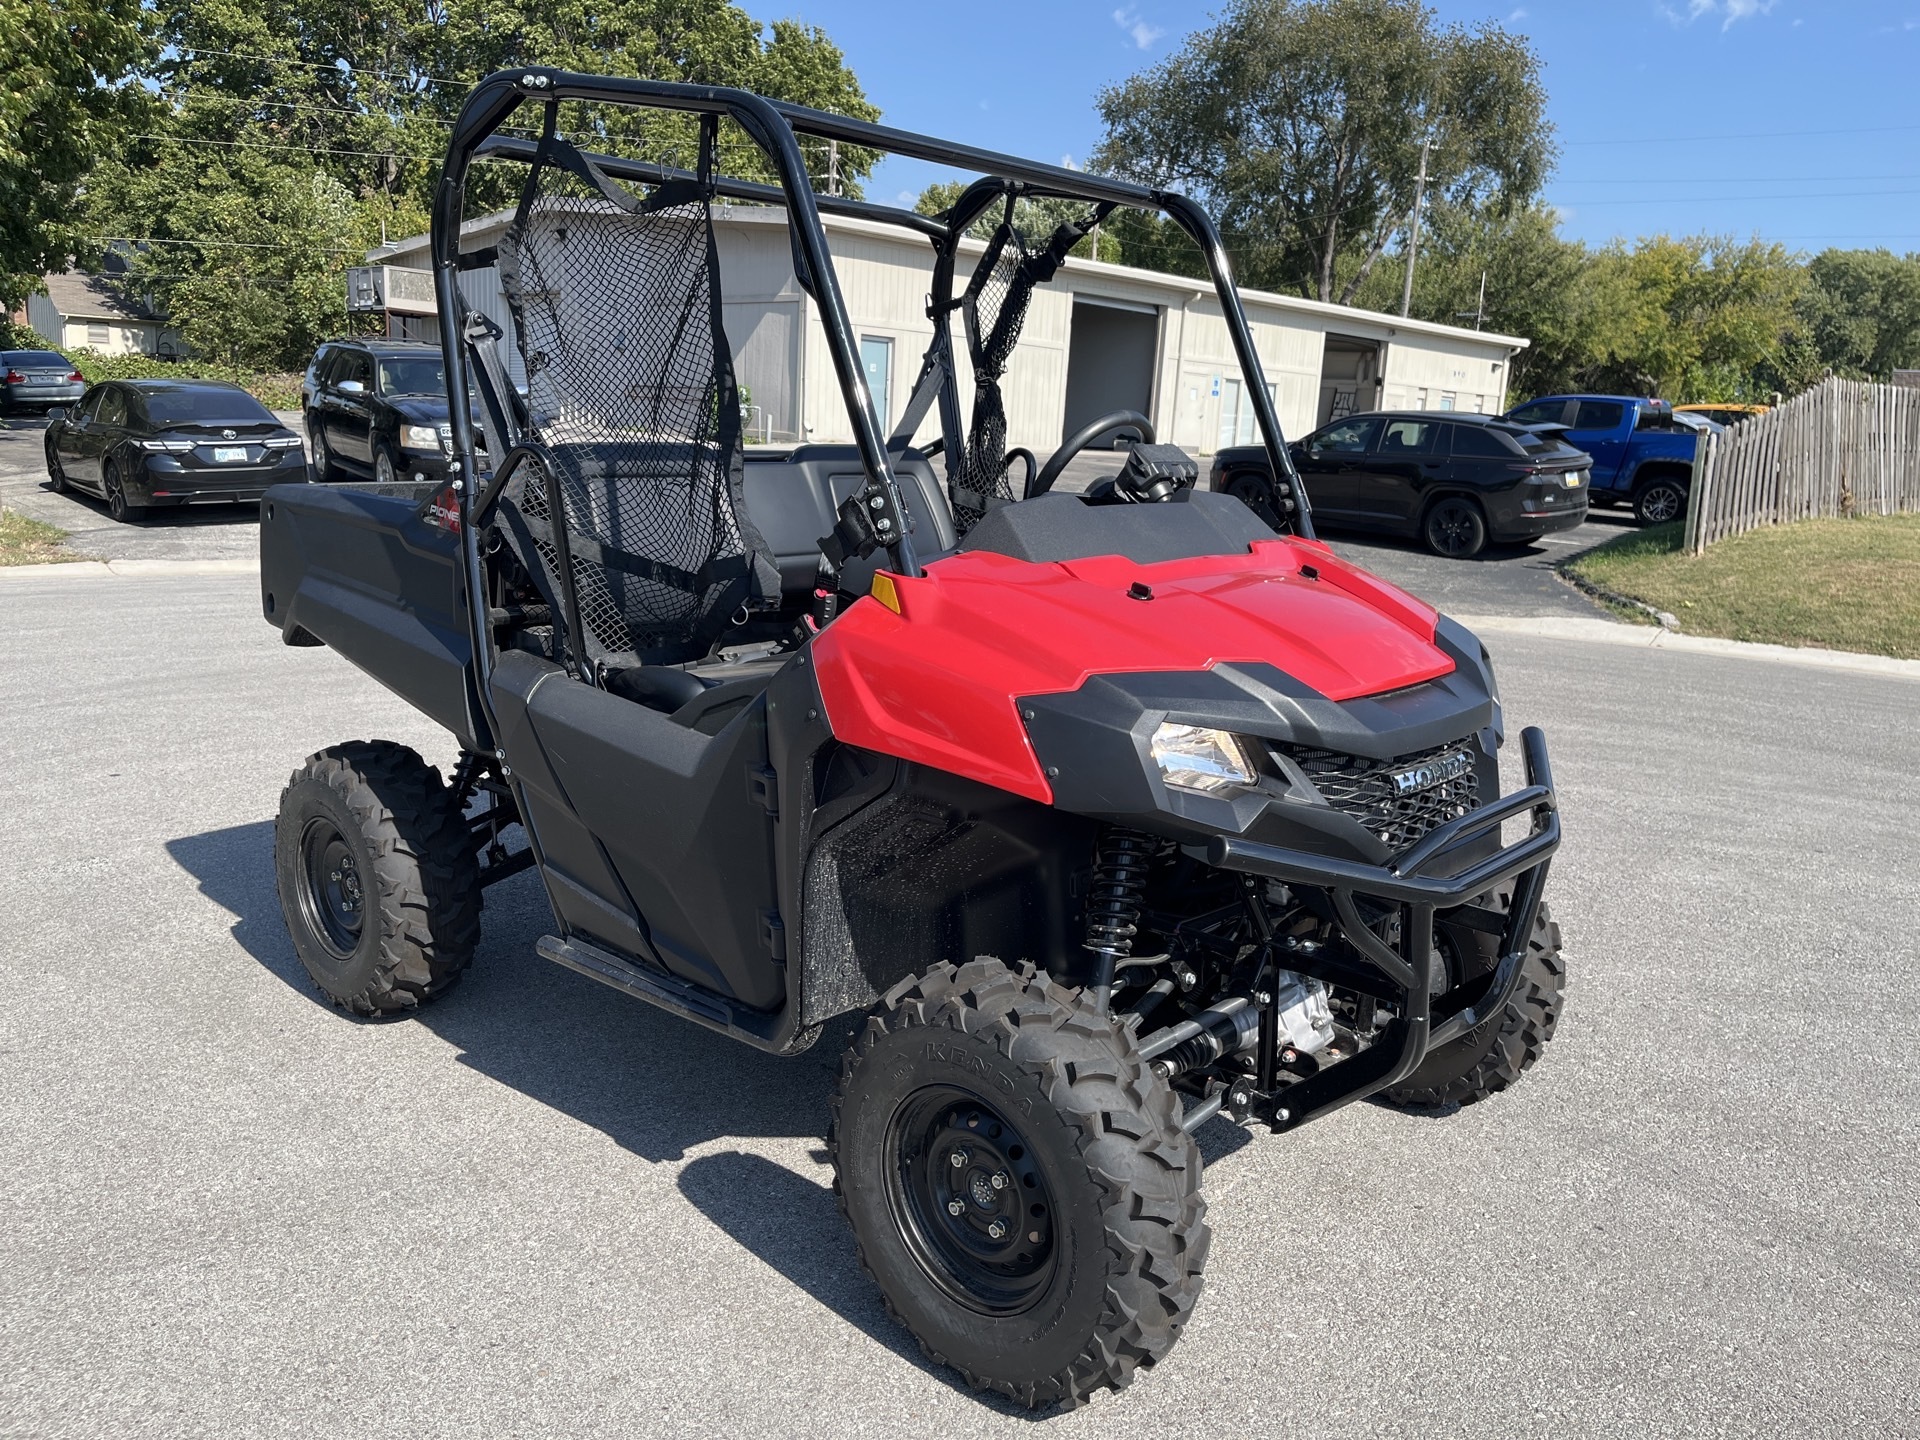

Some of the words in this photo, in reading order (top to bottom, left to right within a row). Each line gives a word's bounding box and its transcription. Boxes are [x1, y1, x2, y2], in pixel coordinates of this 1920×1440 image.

[430, 504, 460, 521] PIONE
[1394, 753, 1468, 793] HONDA
[926, 1042, 1033, 1118] KENDA
